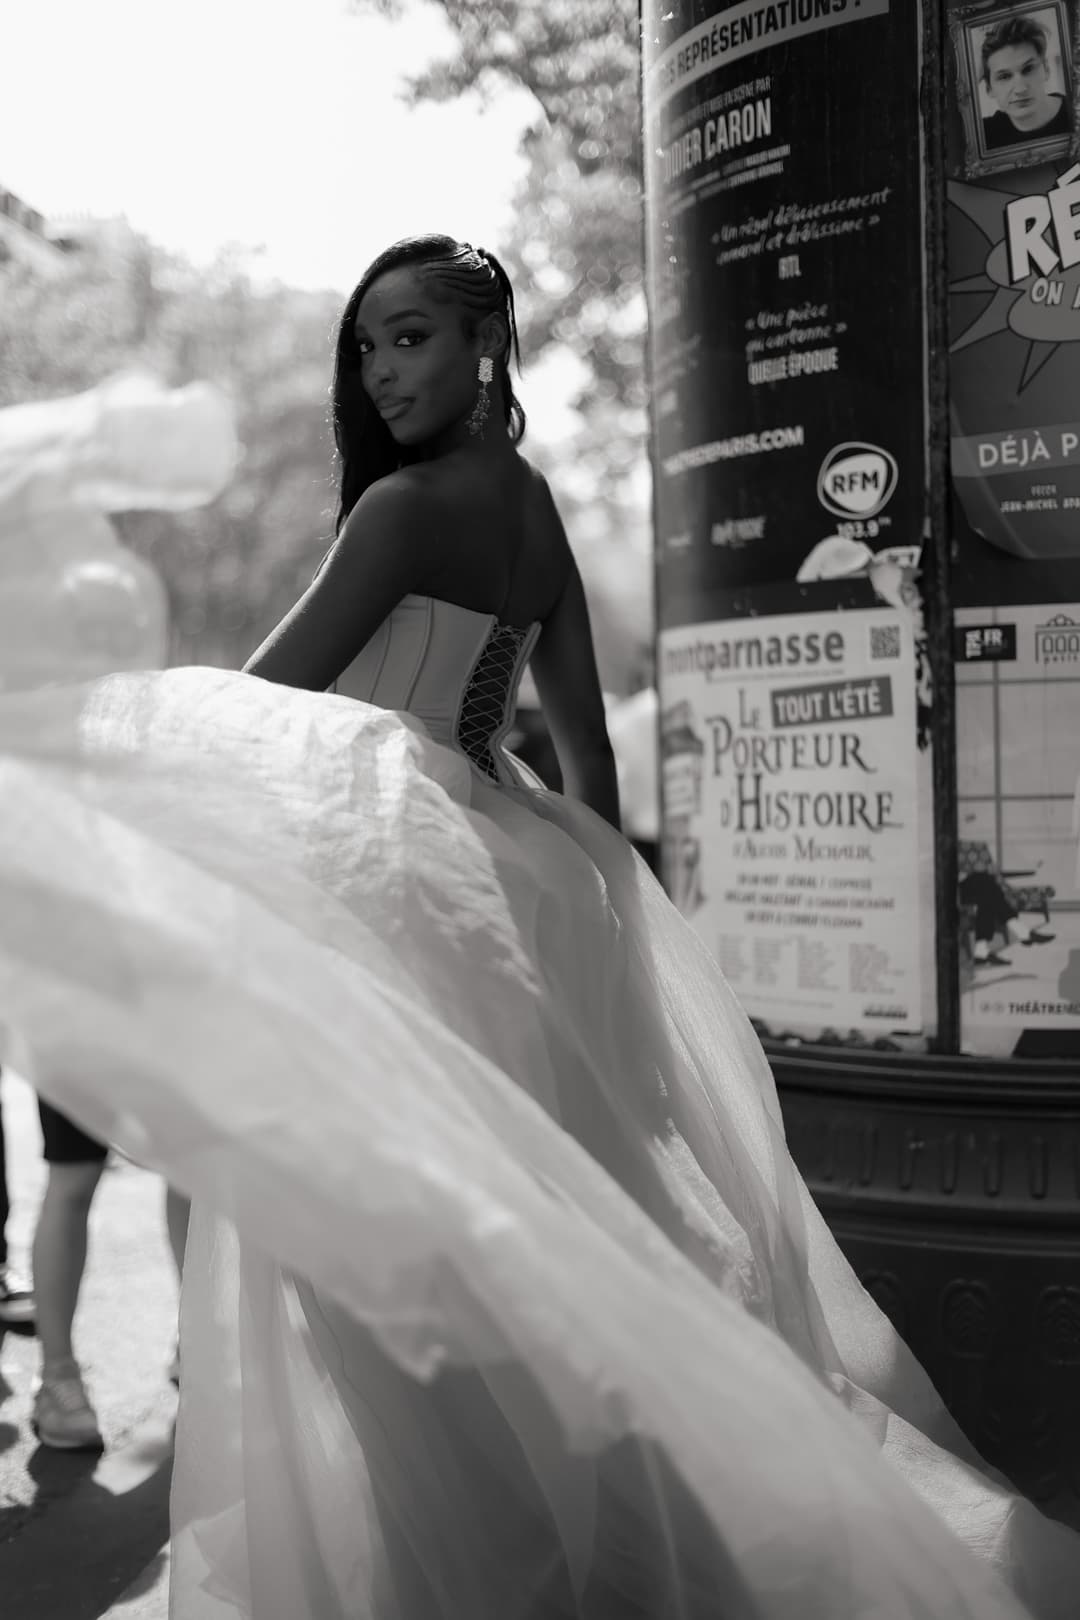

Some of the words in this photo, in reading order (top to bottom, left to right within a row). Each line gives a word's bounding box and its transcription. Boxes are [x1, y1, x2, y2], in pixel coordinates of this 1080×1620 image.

[704, 97, 772, 161] CARON
[1032, 277, 1063, 304] ON
[978, 430, 1050, 467] DÉJÀ
[831, 470, 880, 494] RFM
[776, 695, 824, 722] TOUT
[829, 680, 882, 717] L'ÉTÉ
[706, 714, 878, 778] PORTEUR
[1008, 1000, 1080, 1015] THÉÂTRE
